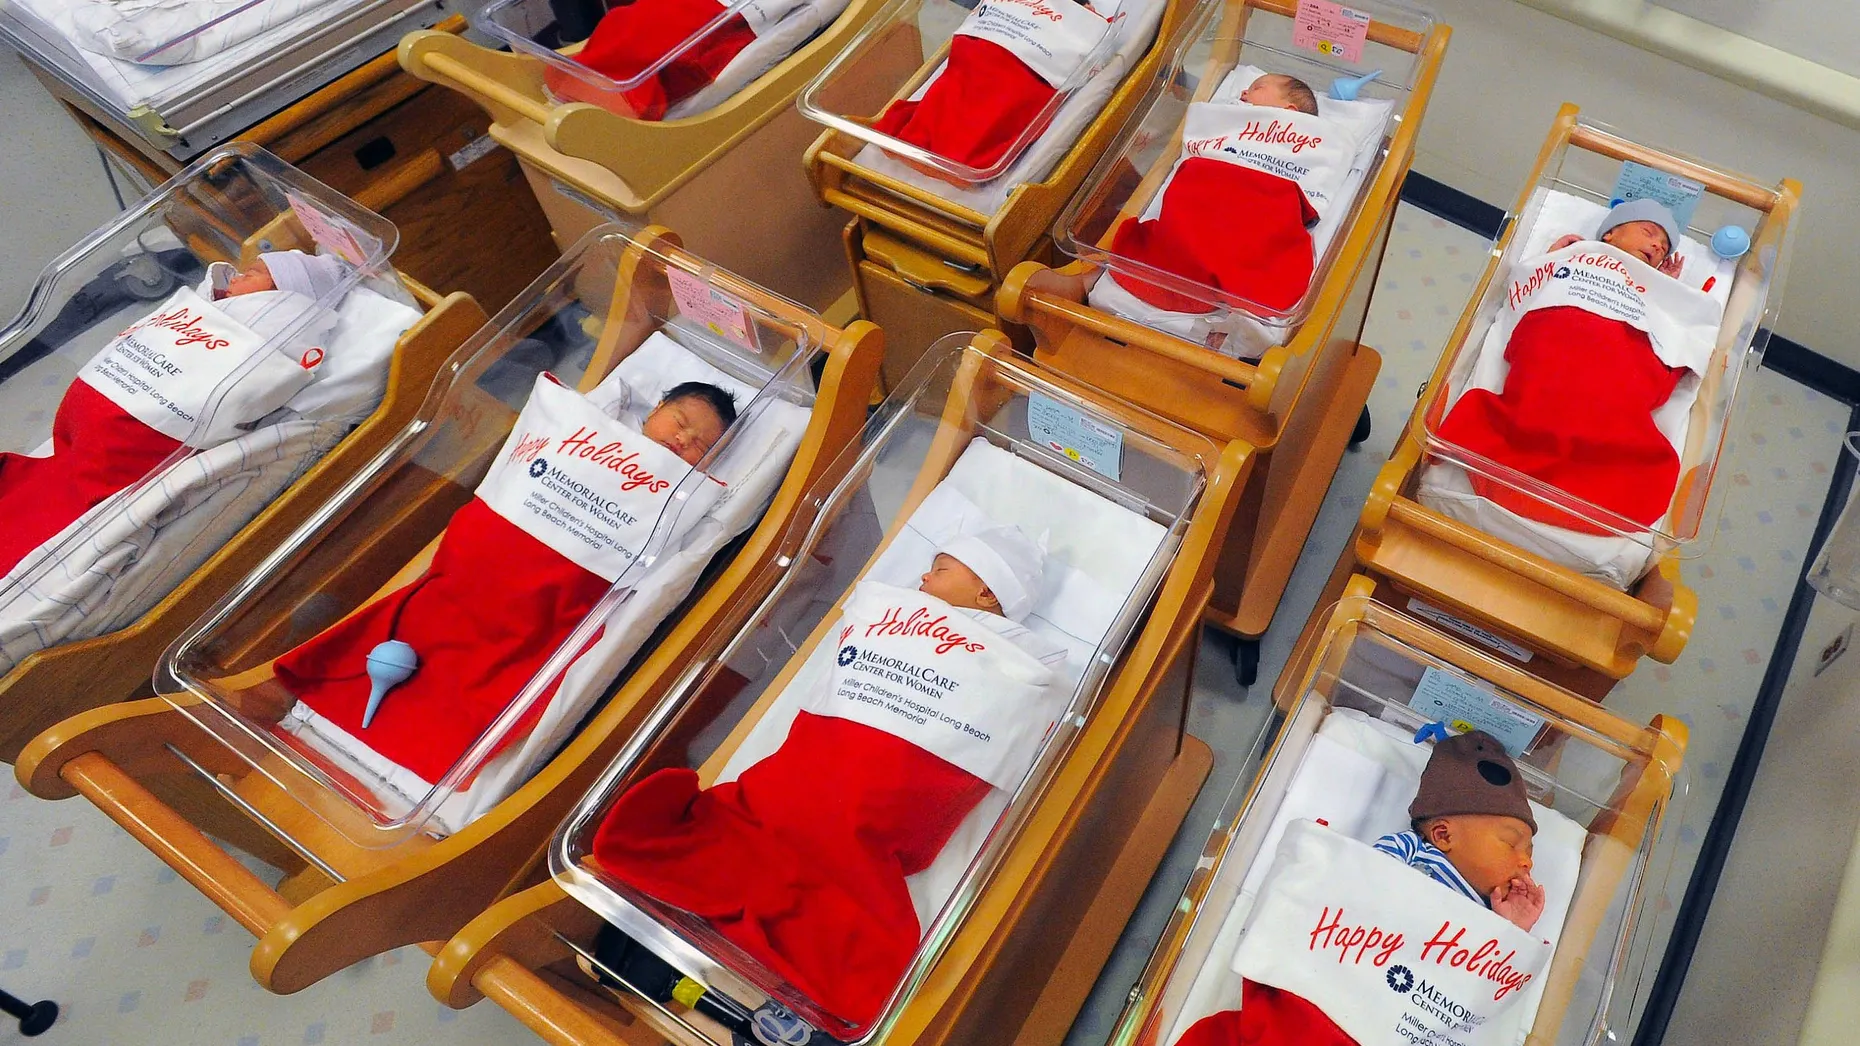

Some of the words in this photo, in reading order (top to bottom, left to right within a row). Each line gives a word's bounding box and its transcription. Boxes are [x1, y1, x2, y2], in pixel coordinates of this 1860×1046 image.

[1238, 120, 1323, 153] Holidays
[1275, 166, 1300, 181] WOMEN
[1509, 261, 1556, 311] Happy
[1572, 275, 1600, 289] CENTER
[1602, 285, 1616, 295] FOR
[1568, 291, 1586, 300] Long
[1586, 295, 1609, 309] Beach
[1609, 304, 1640, 321] Memorial
[150, 387, 168, 406] Long
[167, 402, 195, 423] Beach
[557, 426, 669, 494] Holidays
[541, 476, 571, 500] CENTER
[572, 496, 588, 511] FOR
[589, 504, 621, 530] WOMEN
[523, 499, 541, 514] Long
[541, 509, 567, 529] Beach
[567, 525, 602, 550] Memorial
[531, 491, 548, 504] Miller
[548, 501, 584, 527] Children's
[584, 523, 615, 545] Hospital
[614, 542, 633, 561] Long
[865, 607, 985, 654] Holidays
[852, 661, 884, 678] CENTER
[885, 670, 903, 684] FOR
[906, 677, 943, 700] WOMEN
[837, 688, 856, 700] Long
[857, 690, 884, 708] Beach
[885, 702, 927, 726] Memorial
[842, 678, 863, 689] Miller
[863, 683, 903, 703] Children's
[904, 699, 940, 719] Hospital
[940, 712, 962, 730] Long
[963, 723, 991, 743] Beach
[1309, 906, 1404, 968] Happy
[1420, 921, 1532, 1000] Holidays
[1401, 1012, 1428, 1033] Miller
[1412, 993, 1453, 1028] CENTER
[1395, 1023, 1419, 1045] Long
